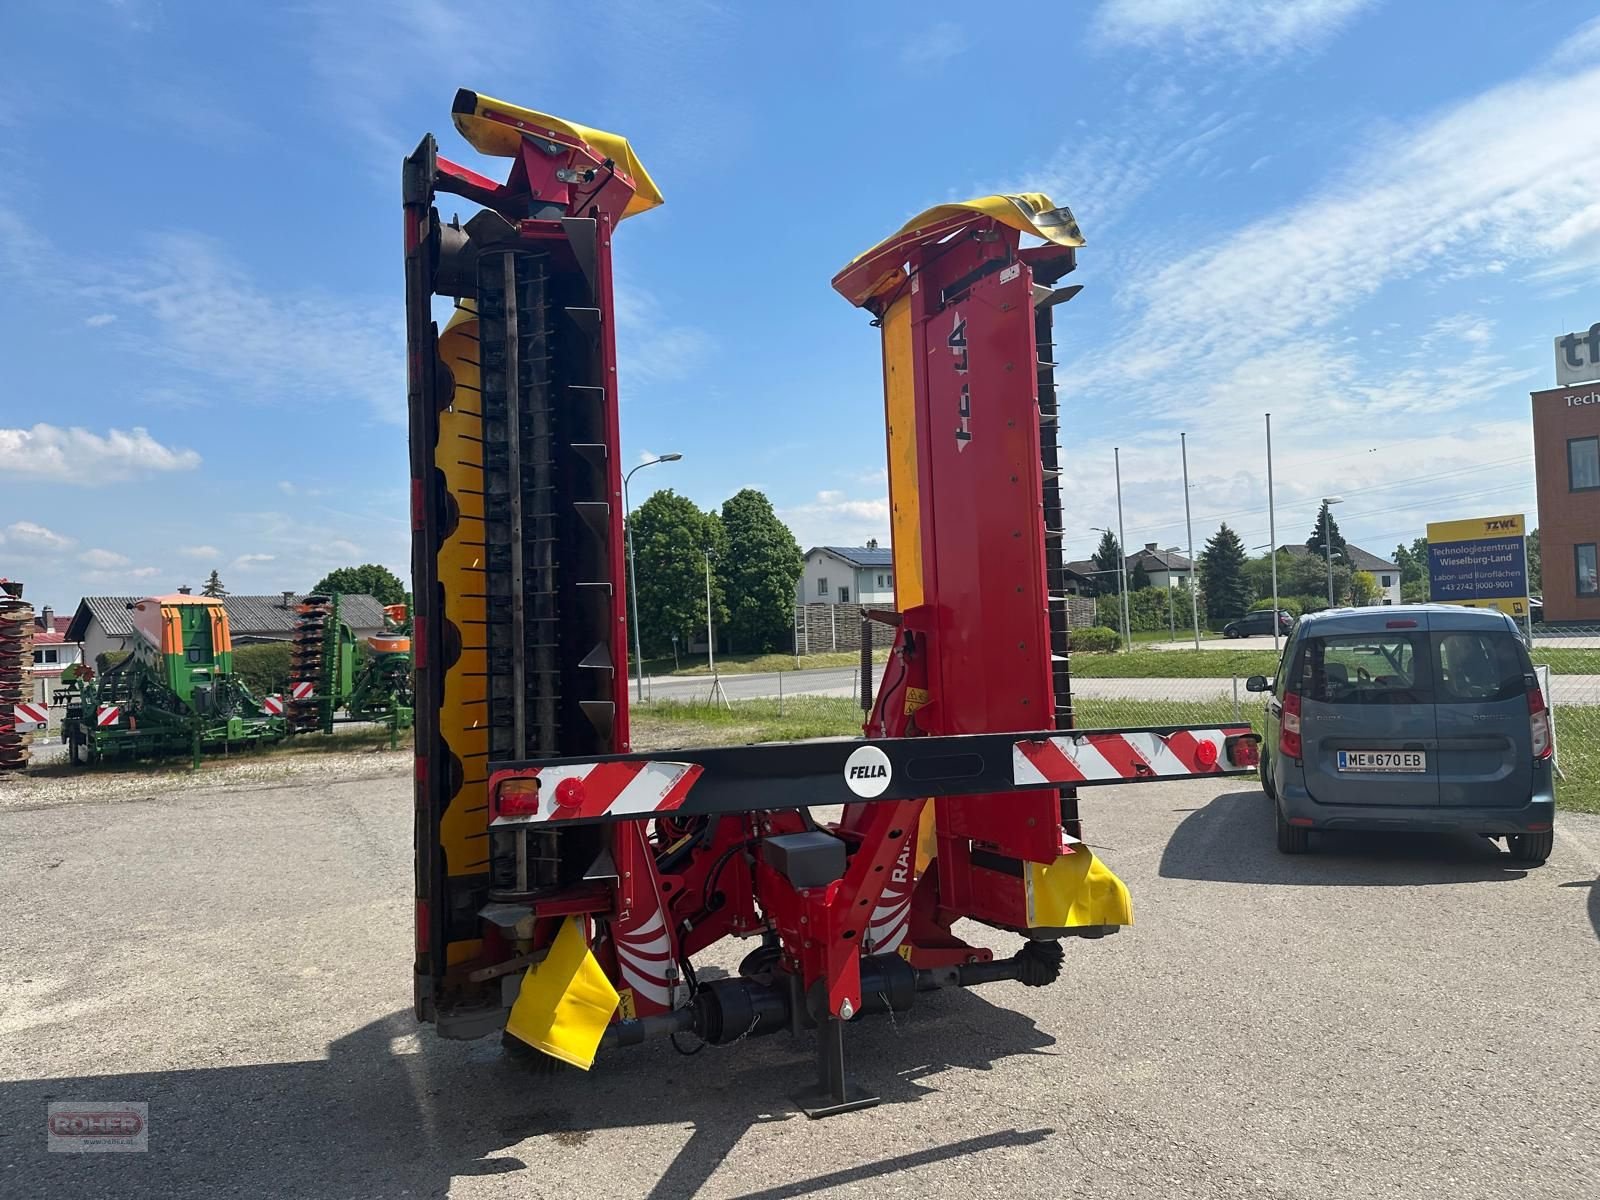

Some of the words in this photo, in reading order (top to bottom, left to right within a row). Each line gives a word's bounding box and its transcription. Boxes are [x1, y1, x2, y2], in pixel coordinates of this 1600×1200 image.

[1487, 519, 1517, 529] TZWL
[1432, 543, 1519, 556] Technologiezentrum
[1439, 553, 1513, 566] Wieselburg-Land
[1458, 572, 1473, 580] und
[1441, 583, 1455, 591] +43
[1456, 582, 1474, 590] 2742
[1349, 754, 1366, 766] ME
[1376, 754, 1401, 766] 670
[1404, 754, 1421, 766] EB
[849, 765, 887, 779] FELLA
